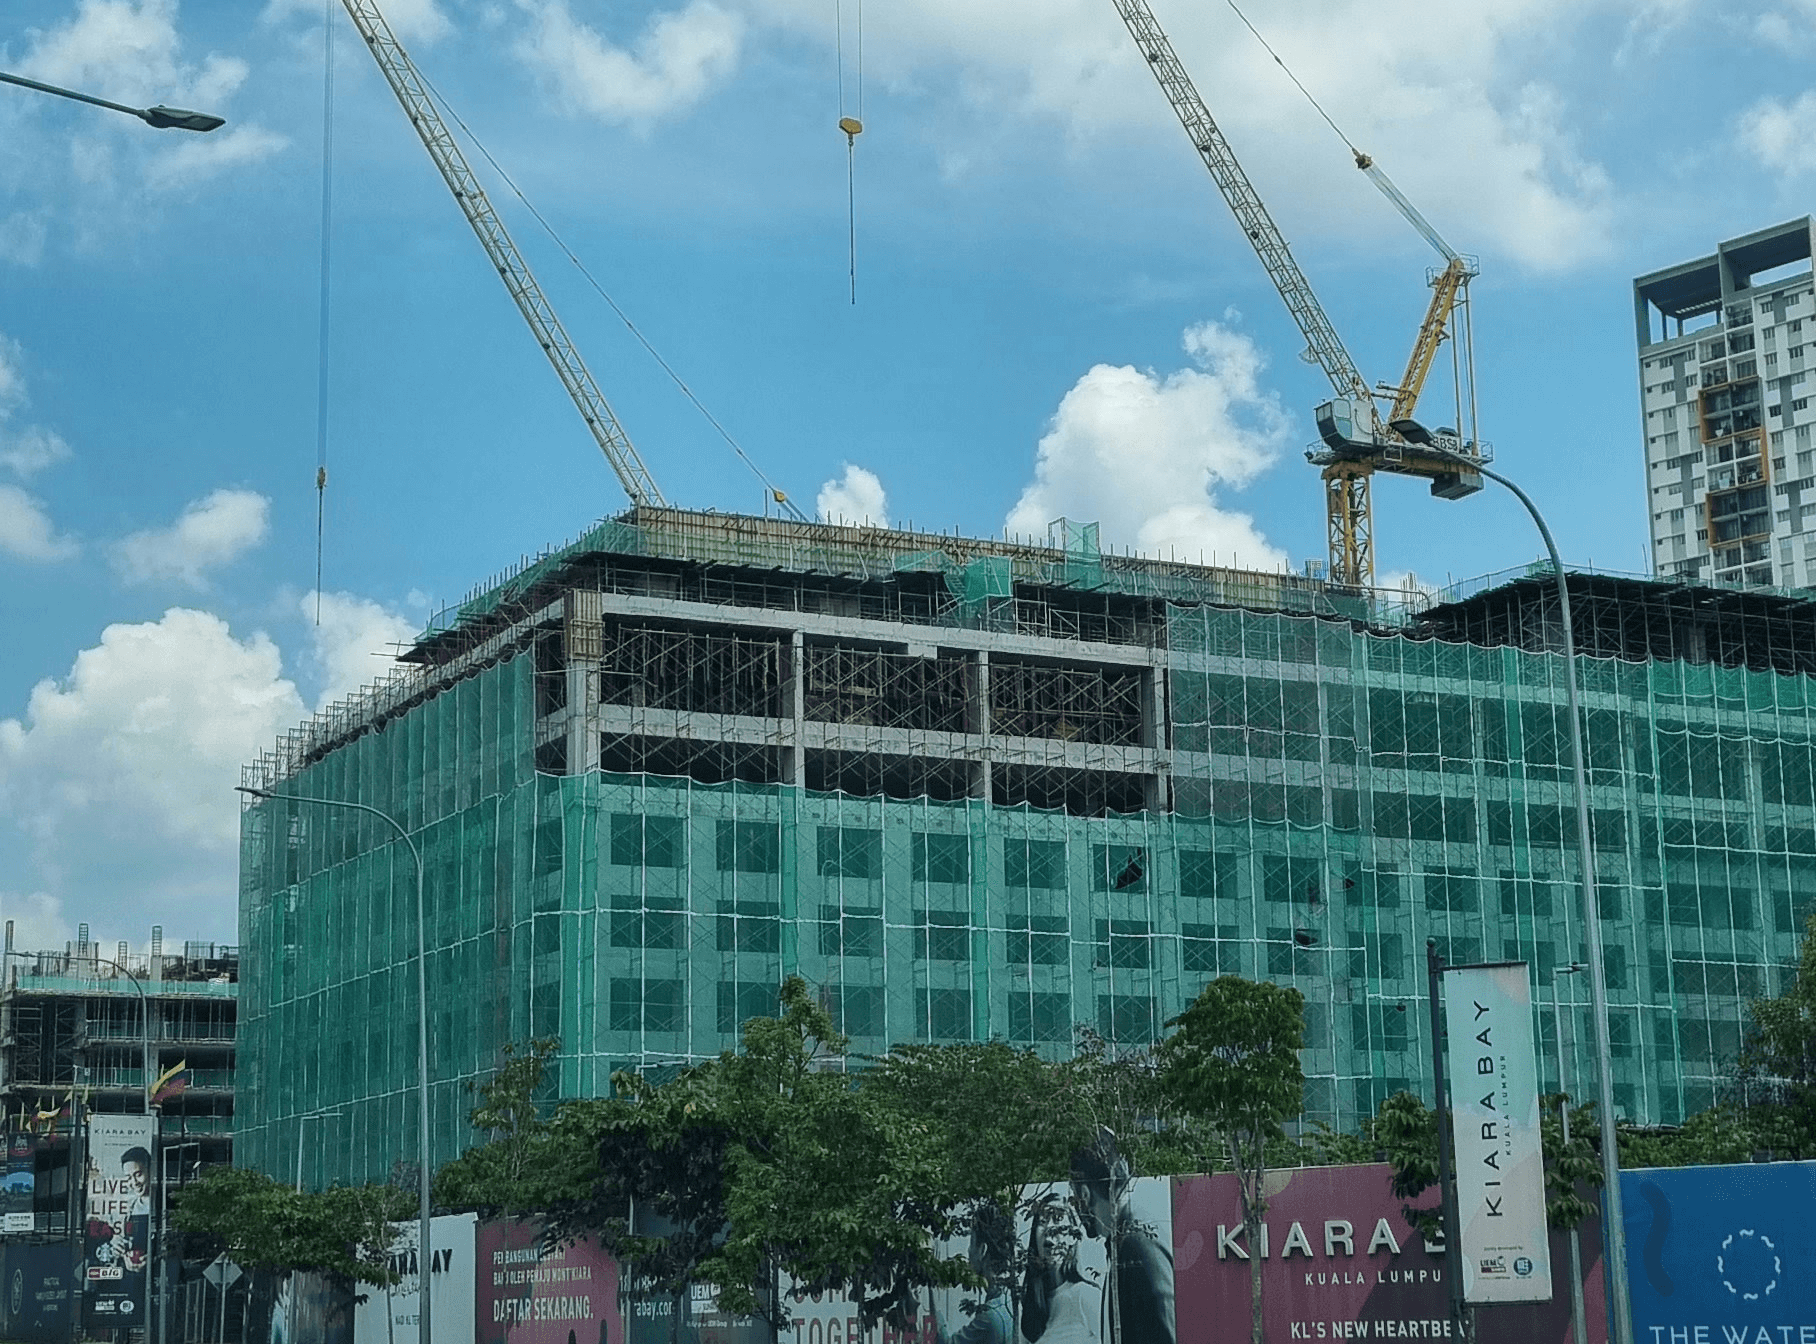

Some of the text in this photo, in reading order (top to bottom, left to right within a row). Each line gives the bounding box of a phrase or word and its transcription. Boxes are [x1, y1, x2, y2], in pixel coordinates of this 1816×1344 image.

[1473, 1000, 1503, 1217] KIARA BAY
[1500, 1056, 1512, 1156] KUALA LUMPUR
[92, 1179, 129, 1195] LIVE
[91, 1200, 128, 1215] LIFE
[1217, 1218, 1401, 1259] KIARA
[1305, 1269, 1442, 1286] KUALA LUMPU
[690, 1284, 710, 1300] UEM
[493, 1295, 594, 1323] DAFTAR SEKARANG.
[1290, 1318, 1470, 1340] KL'S NEW HEARTBEA
